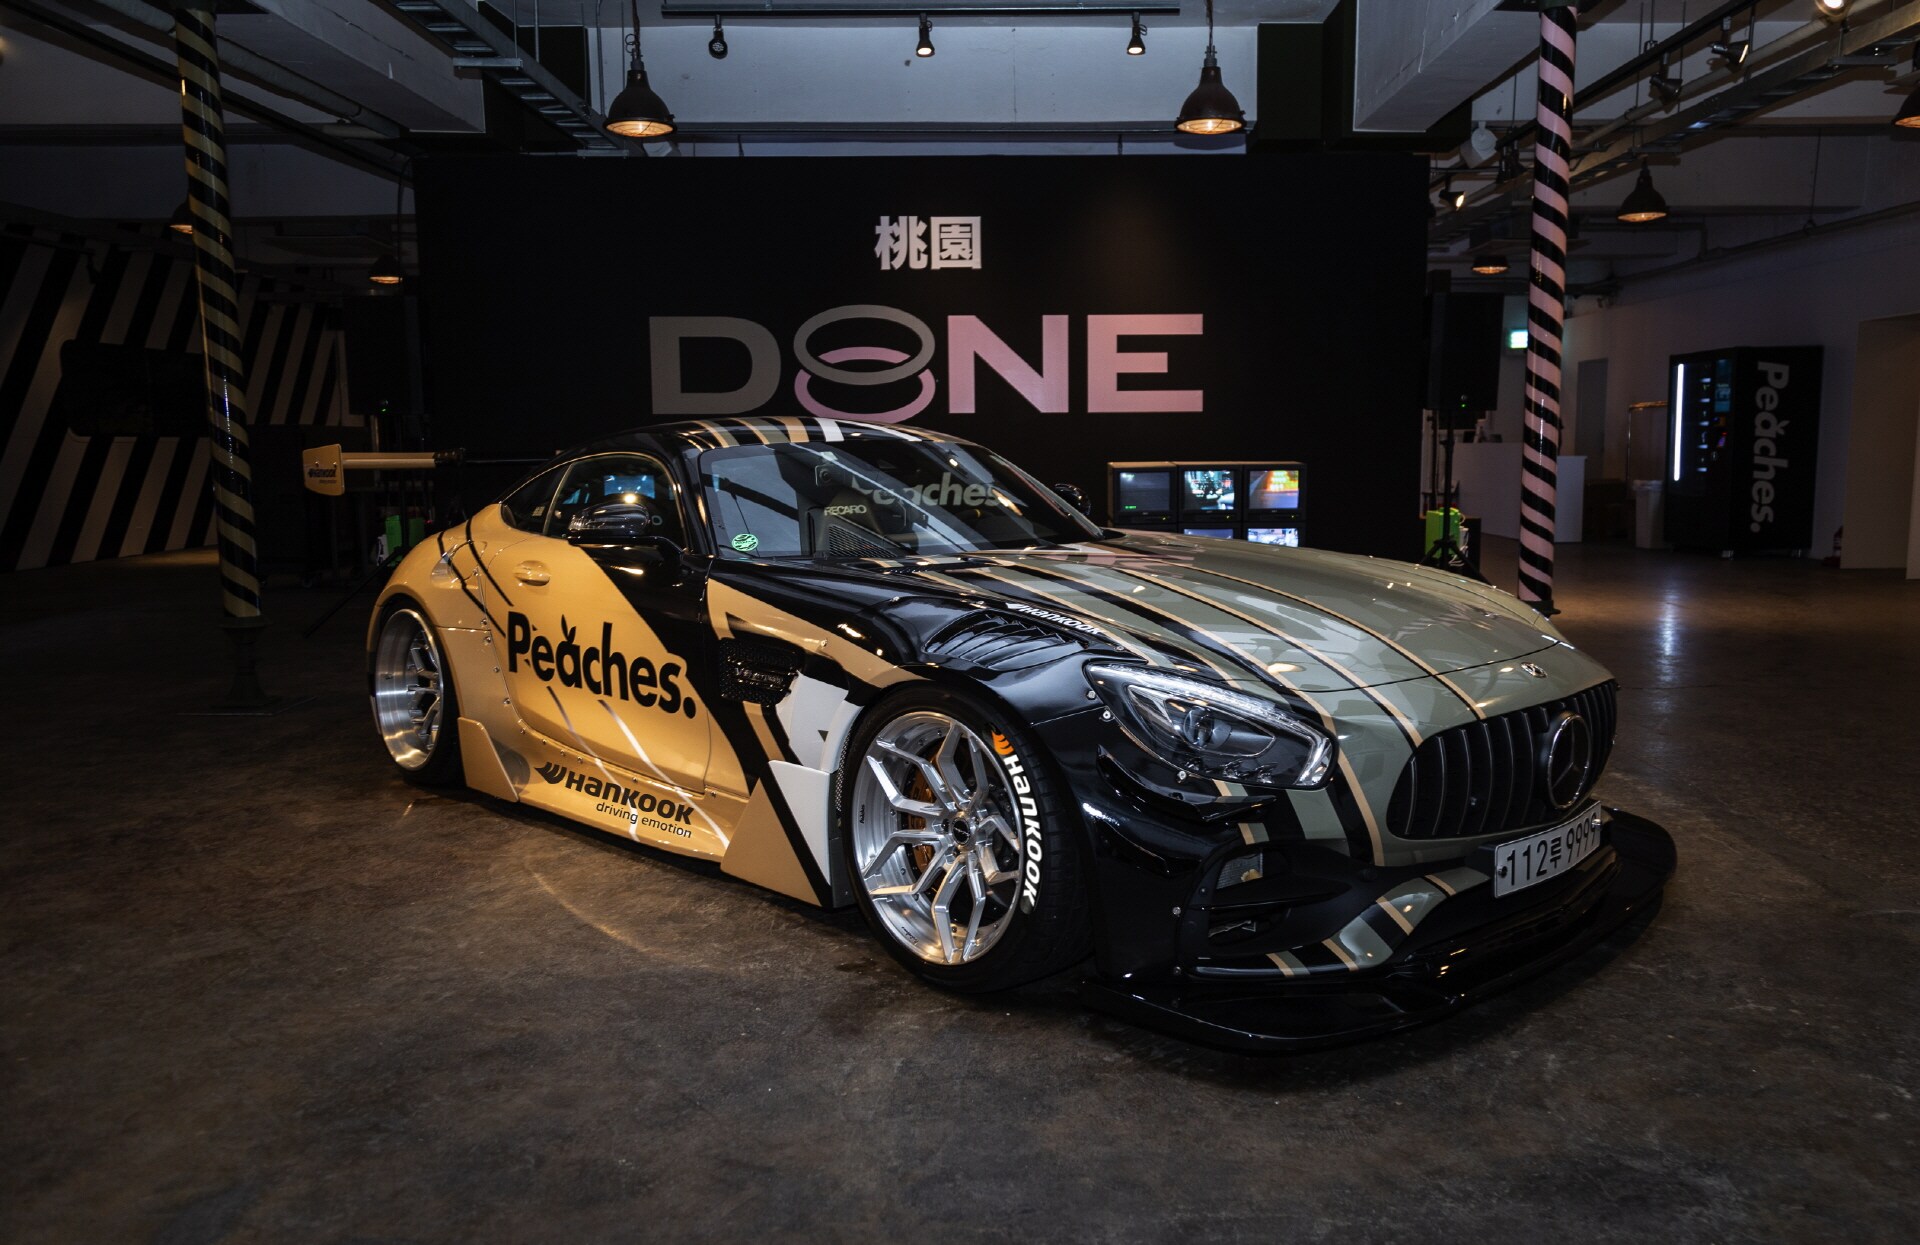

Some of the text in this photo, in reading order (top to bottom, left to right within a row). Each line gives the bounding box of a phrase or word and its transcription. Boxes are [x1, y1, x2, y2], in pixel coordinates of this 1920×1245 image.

[874, 216, 982, 270] 桃園
[649, 304, 1204, 424] DONE
[1750, 360, 1791, 533] Peaches.
[824, 504, 867, 517] RECARO
[508, 611, 697, 719] Peaches.
[596, 801, 692, 839] driving emotion
